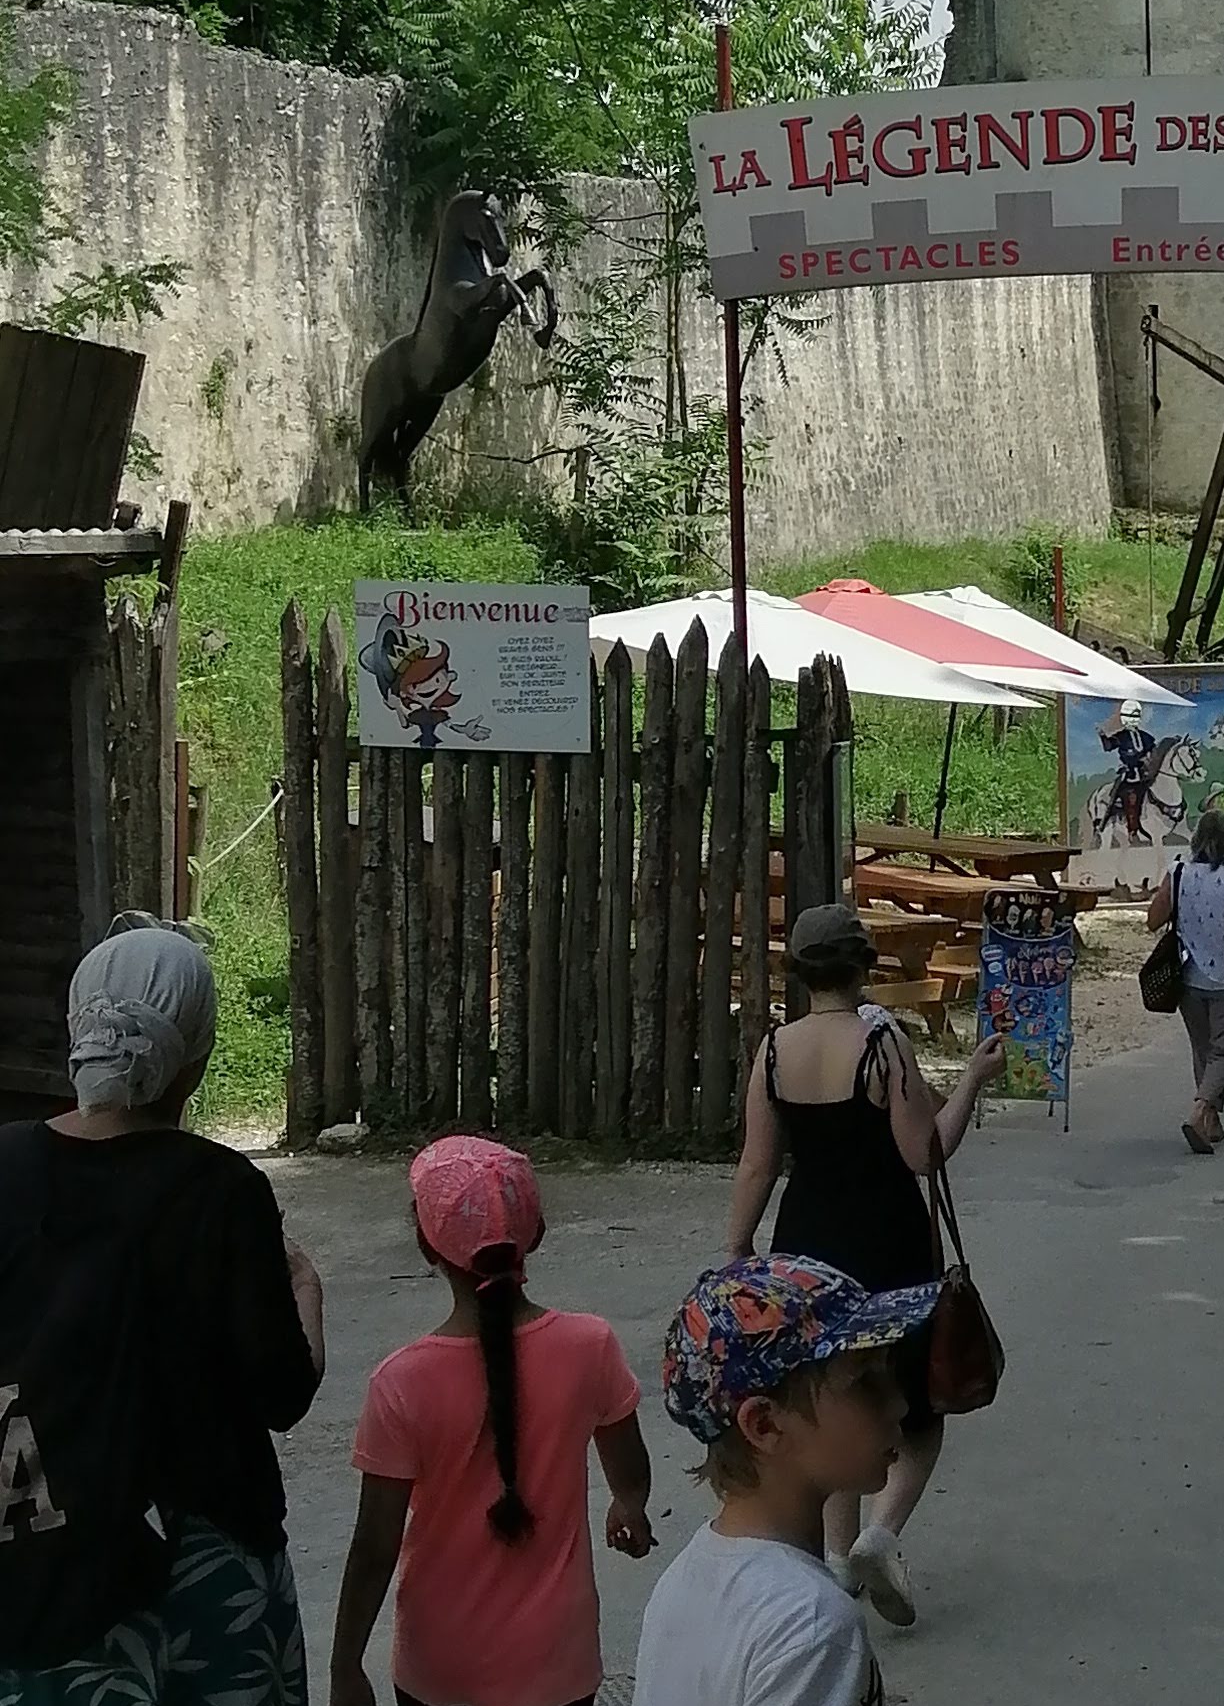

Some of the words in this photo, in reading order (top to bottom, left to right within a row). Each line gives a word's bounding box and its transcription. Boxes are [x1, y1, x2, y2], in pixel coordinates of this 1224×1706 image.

[708, 149, 772, 195] LA
[780, 101, 1138, 195] LÉGENDE
[778, 239, 1021, 280] SPECTACLES
[383, 590, 560, 628] Bienvenue
